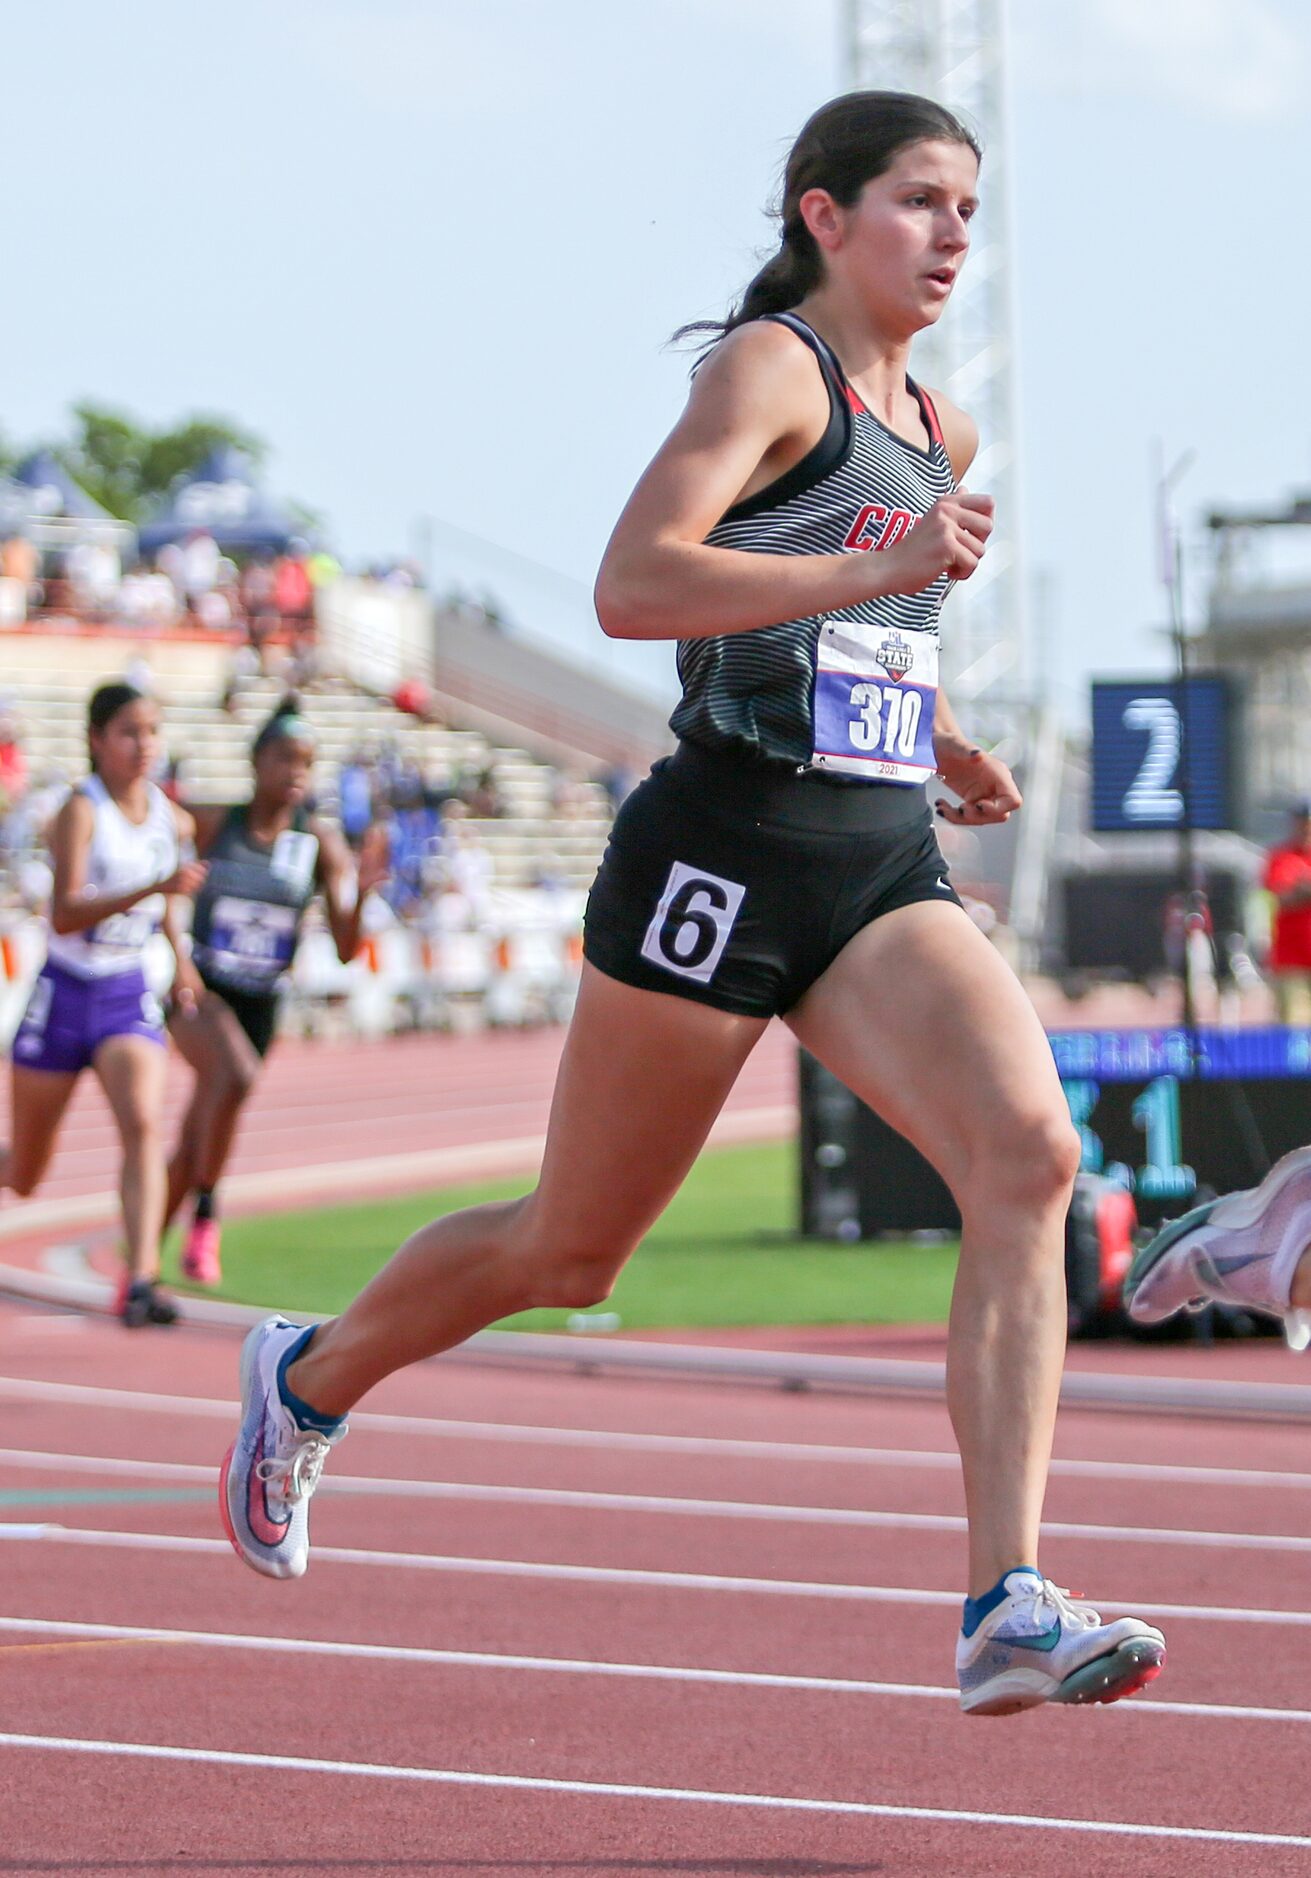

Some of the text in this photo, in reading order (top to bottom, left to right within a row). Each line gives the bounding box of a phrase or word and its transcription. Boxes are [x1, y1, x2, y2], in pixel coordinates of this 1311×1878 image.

[843, 503, 925, 553] CO
[876, 648, 914, 668] STATE
[849, 681, 923, 757] 370
[879, 763, 899, 775] 2021
[1121, 698, 1185, 822] 2
[658, 877, 729, 969] 6
